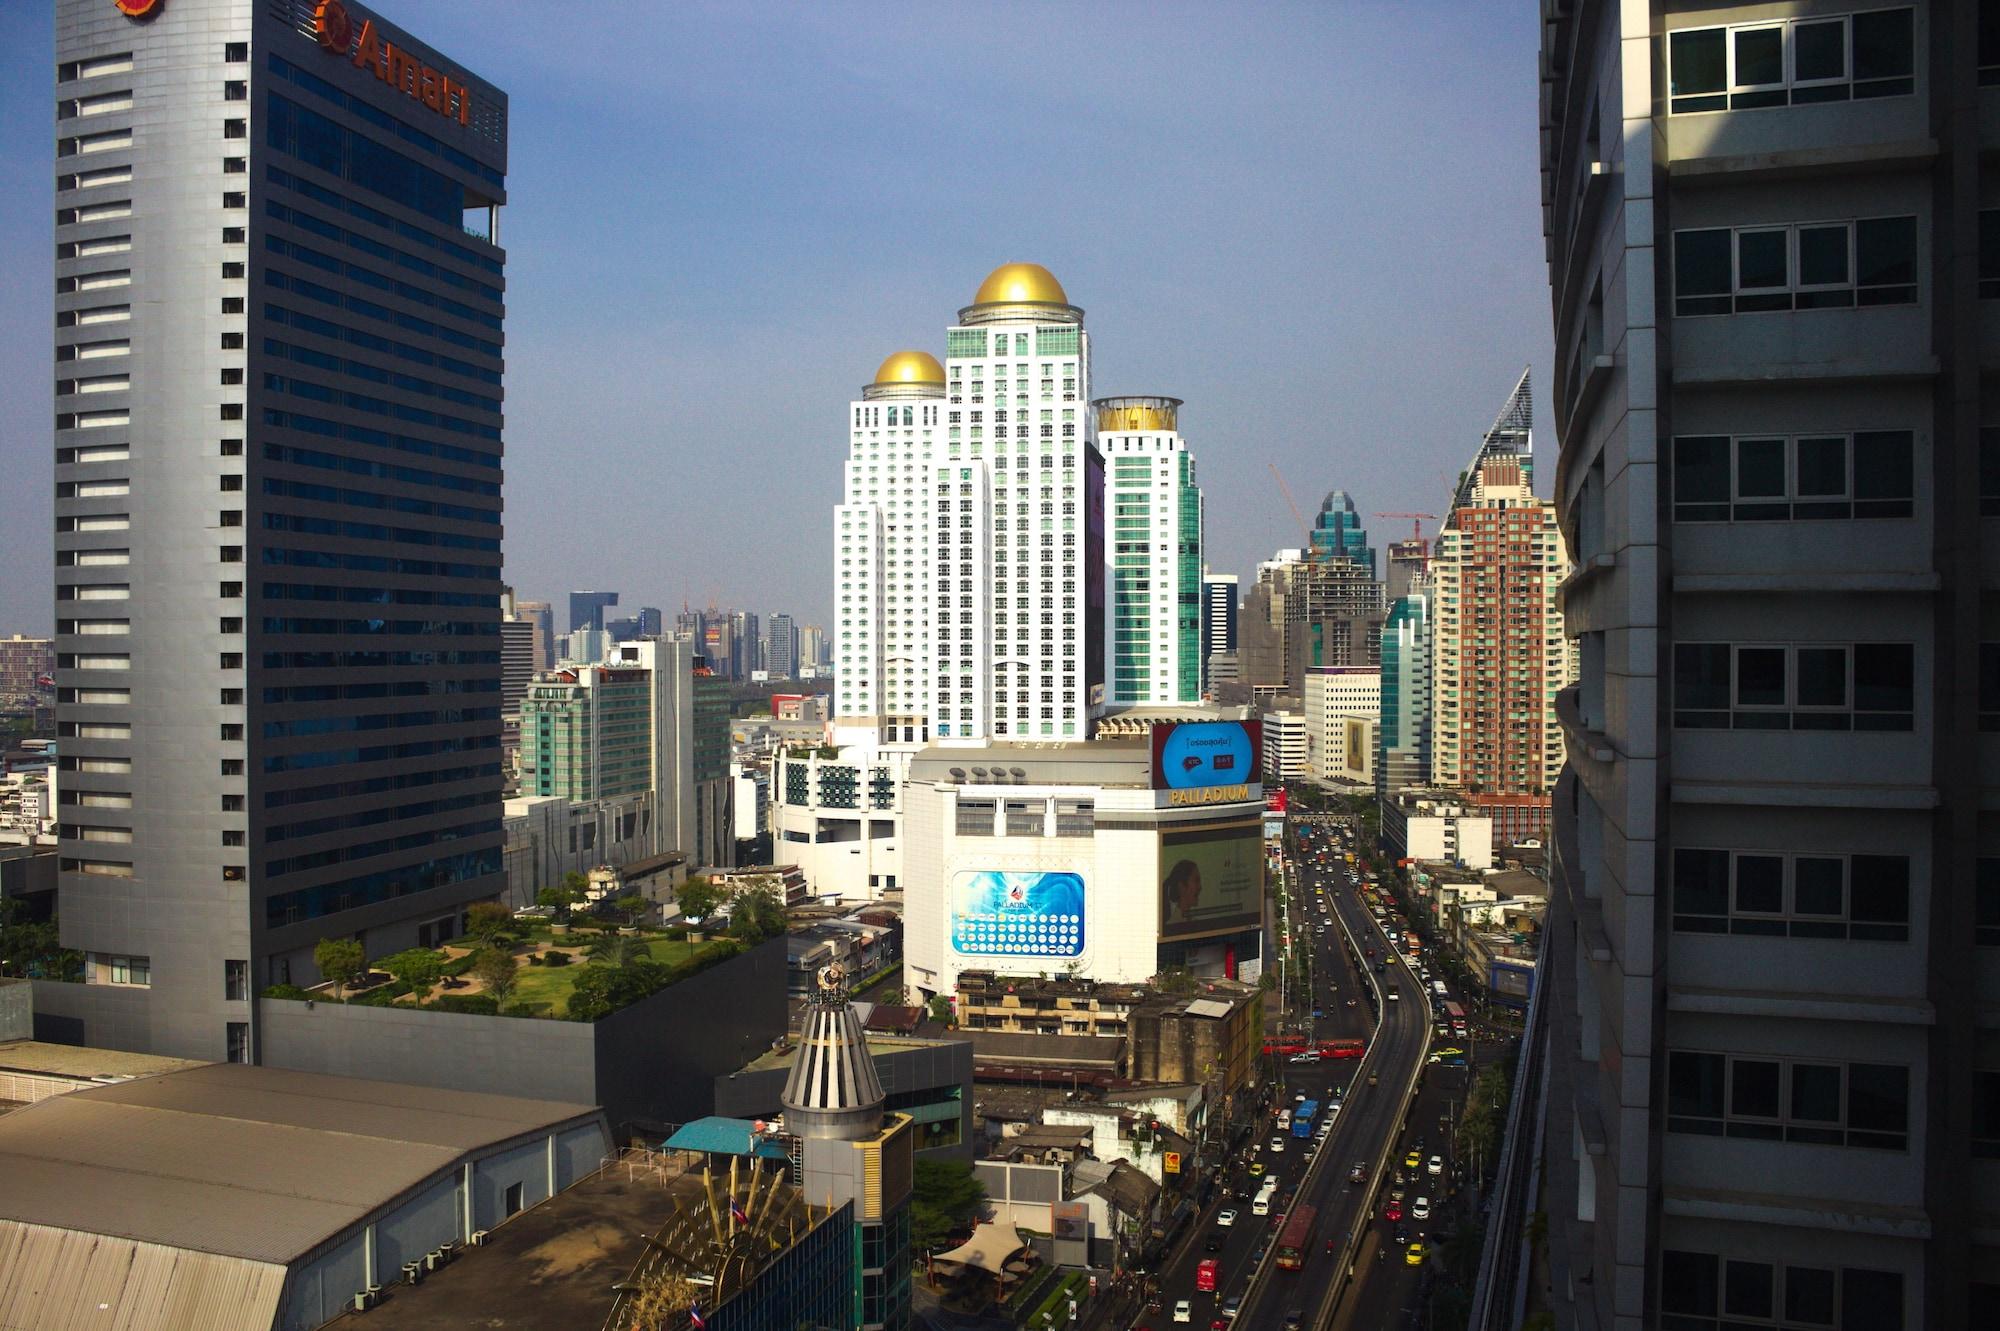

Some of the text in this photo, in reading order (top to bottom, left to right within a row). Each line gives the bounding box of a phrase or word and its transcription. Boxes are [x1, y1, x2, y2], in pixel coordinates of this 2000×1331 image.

[352, 19, 471, 126] Amari
[1171, 784, 1249, 804] PALLADIUM
[993, 901, 1033, 909] PALLADIUM
